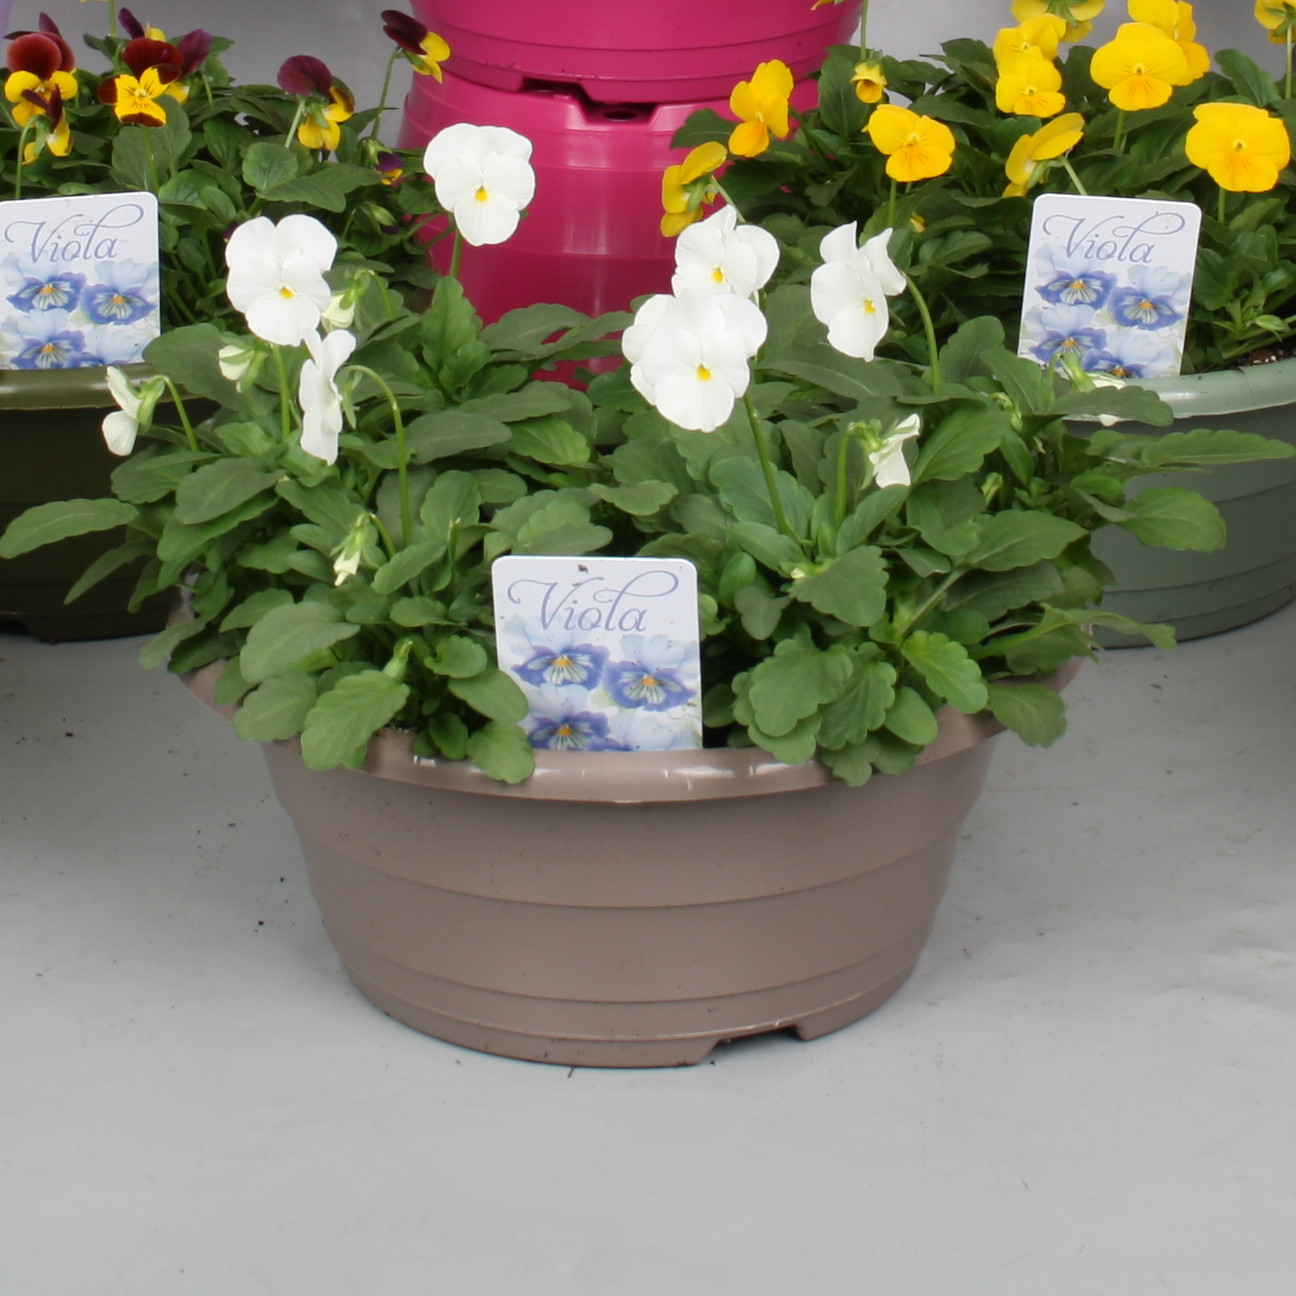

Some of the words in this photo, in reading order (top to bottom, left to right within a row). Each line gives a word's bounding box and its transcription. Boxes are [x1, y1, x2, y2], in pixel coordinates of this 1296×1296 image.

[4, 203, 144, 264] Viola
[1042, 212, 1185, 264] Viola
[507, 570, 679, 632] Viola
